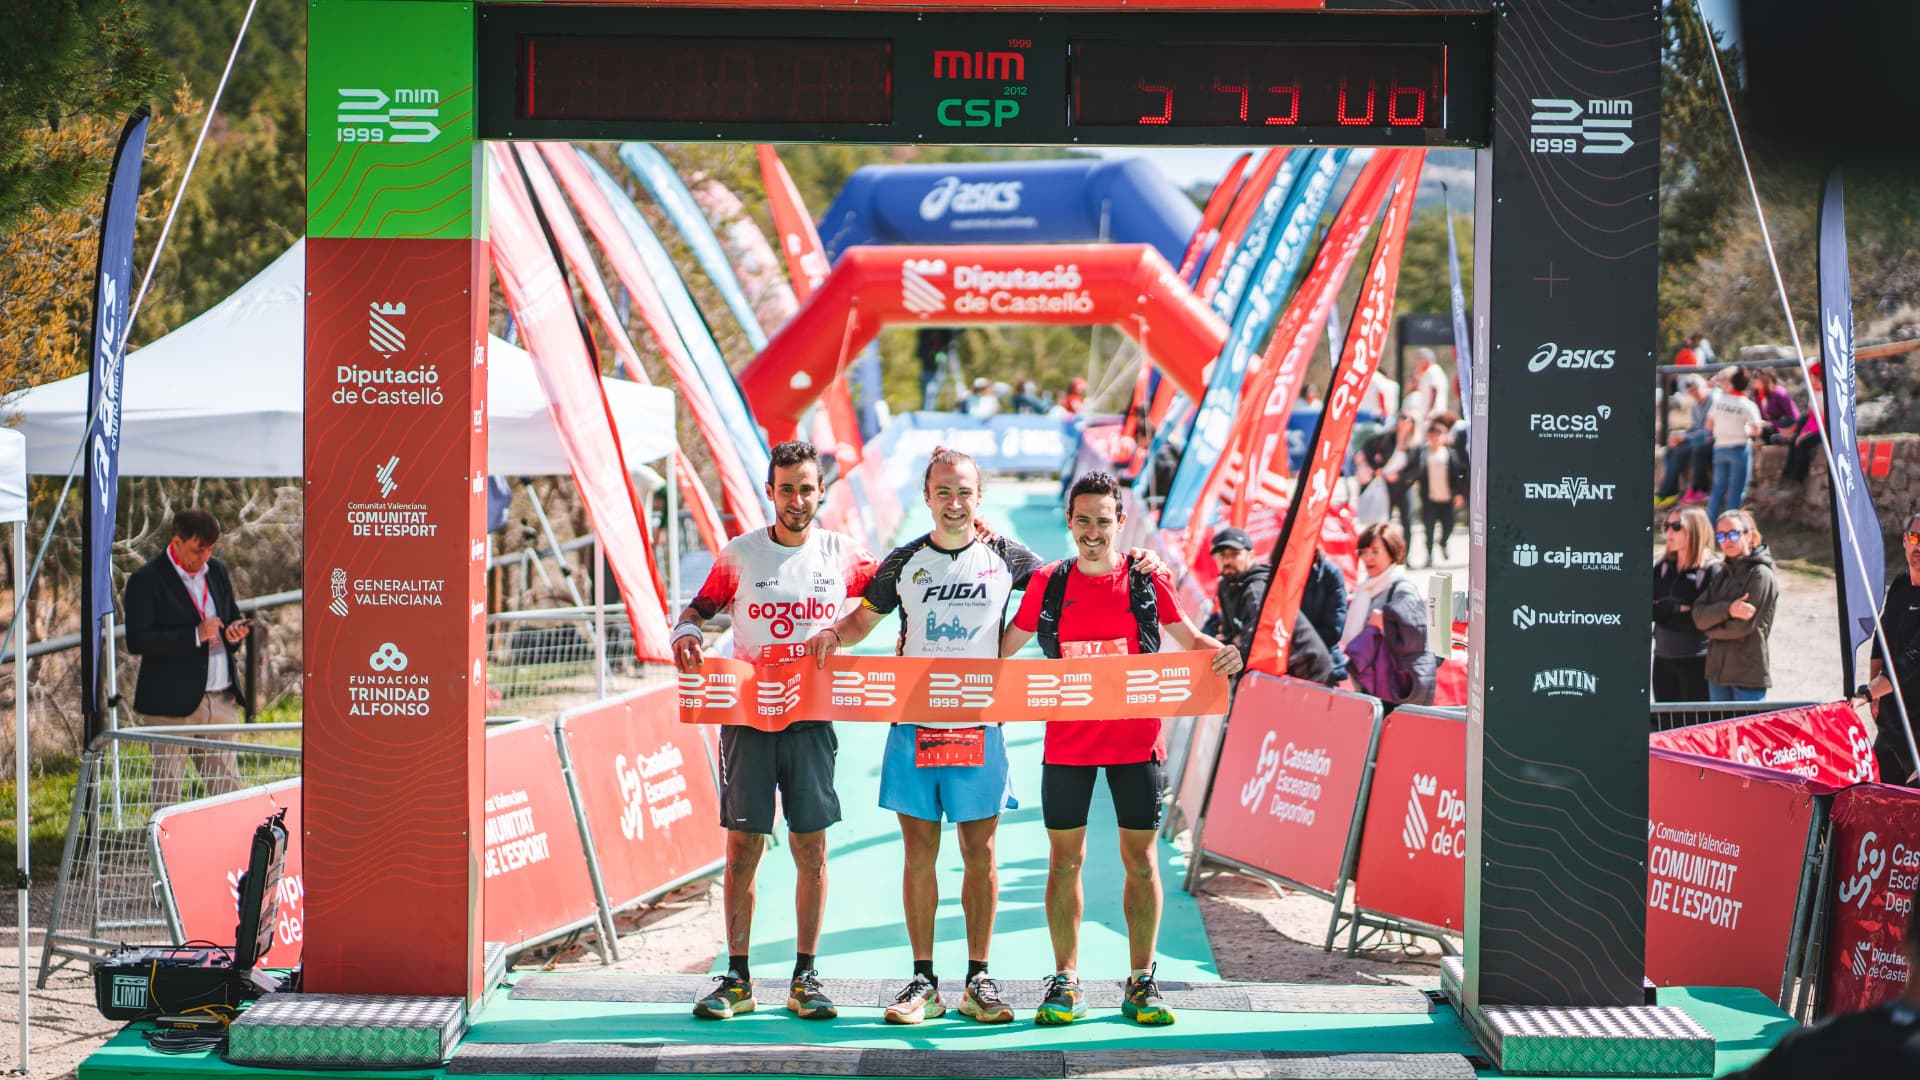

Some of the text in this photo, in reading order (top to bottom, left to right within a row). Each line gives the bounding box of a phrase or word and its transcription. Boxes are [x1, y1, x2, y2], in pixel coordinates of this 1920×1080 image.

[1008, 39, 1032, 48] 1999
[1003, 86, 1028, 96] 2012
[937, 98, 1020, 128] CSP
[337, 127, 384, 143] 1999
[1530, 138, 1577, 153] 1999
[953, 262, 1082, 294] Diputació
[953, 290, 1094, 314] de Castelló
[1556, 349, 1616, 369] asics
[337, 364, 439, 387] Diputació
[332, 386, 444, 405] de Castelló
[1523, 477, 1616, 508] ENDAVANT
[347, 501, 427, 510] Comunitat Valenciana
[347, 511, 428, 524] COMUNITAT
[353, 525, 438, 537] DE L'ESPORT
[1543, 546, 1624, 569] cajamar
[353, 579, 445, 592] GENERALITAT
[921, 583, 987, 603] FUGA
[354, 594, 443, 606] VALENCIANA
[1538, 610, 1622, 625] nutrinovex
[787, 644, 805, 657] 19
[1086, 642, 1103, 654] 17
[349, 674, 430, 685] FUNDACIÓN
[1532, 669, 1597, 693] ANITIN
[348, 687, 430, 702] TRINIDAD
[832, 696, 862, 706] 1999
[1027, 697, 1058, 707] 1999
[1126, 693, 1157, 704] 1999
[348, 703, 430, 716] ALFONSO
[757, 705, 784, 716] 1999
[929, 698, 959, 708] 1999
[1432, 825, 1453, 856] de
[1656, 822, 1741, 858] Comunitat Valenciana
[1649, 845, 1738, 893] COMUNITAT
[1649, 879, 1743, 930] DE L'ESPORT
[114, 985, 147, 1007] LIMIT
